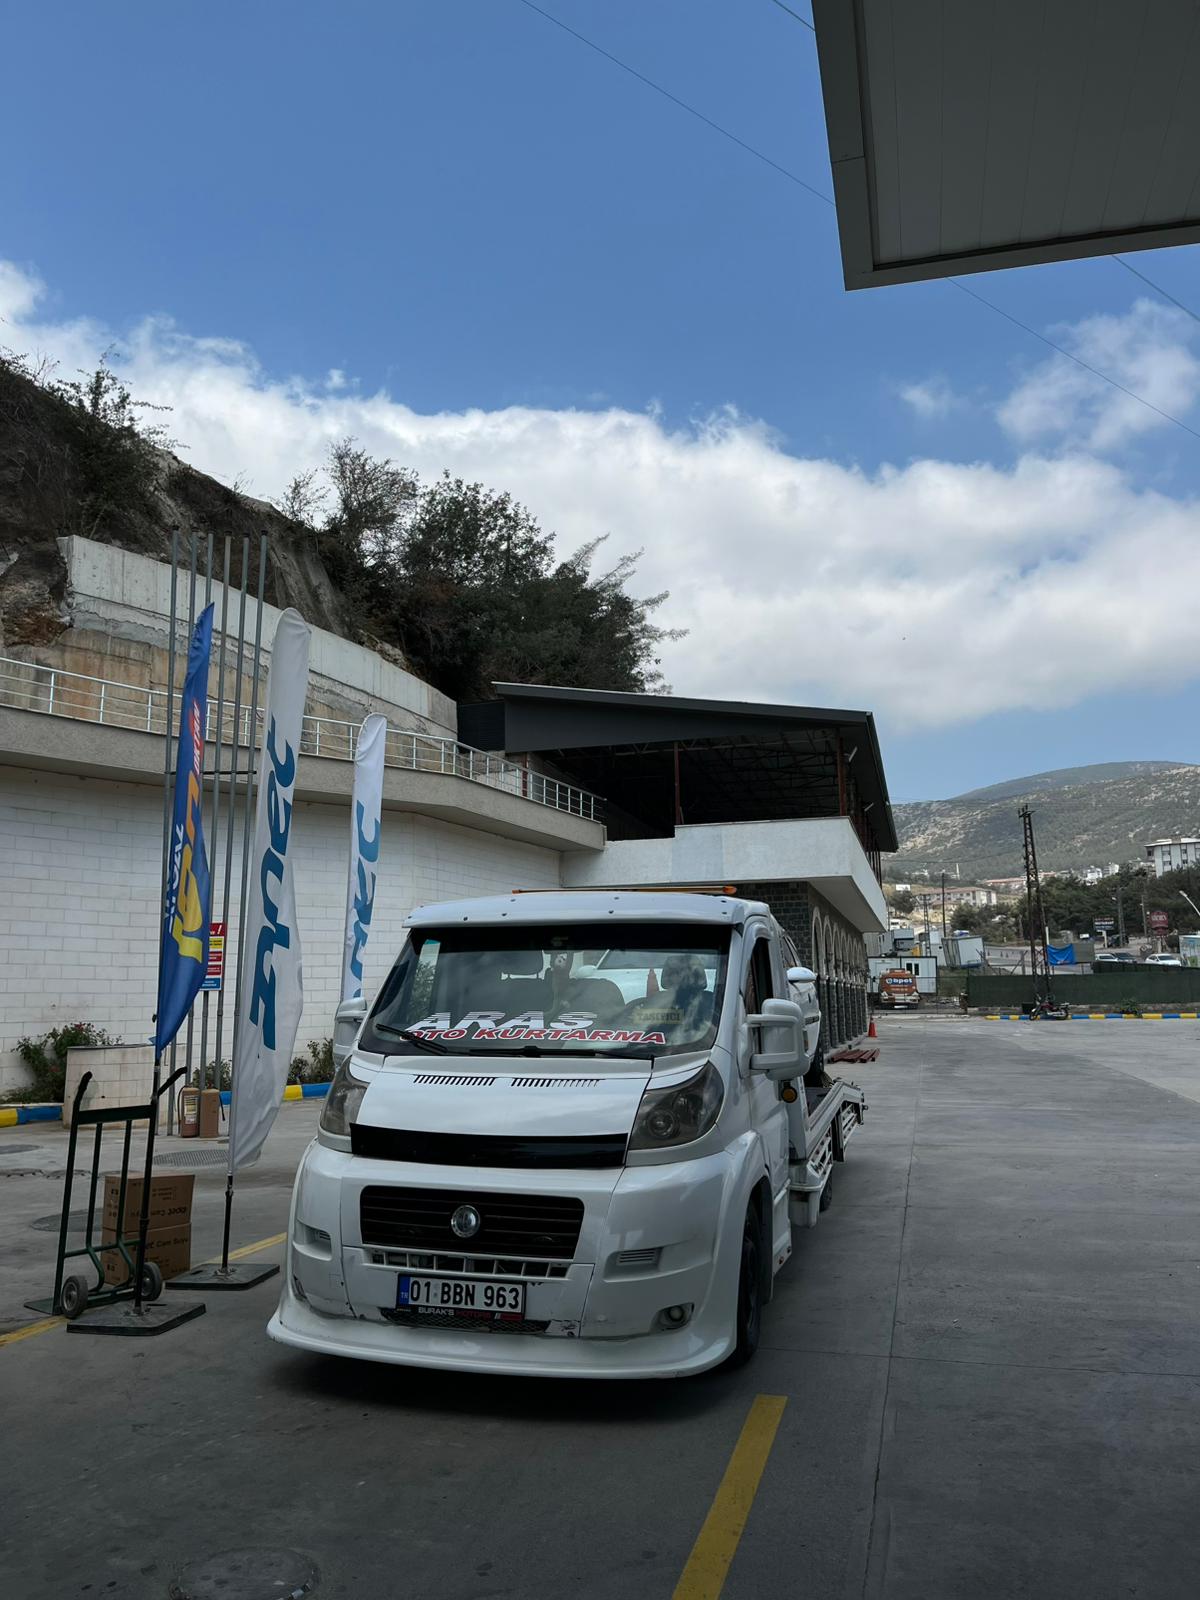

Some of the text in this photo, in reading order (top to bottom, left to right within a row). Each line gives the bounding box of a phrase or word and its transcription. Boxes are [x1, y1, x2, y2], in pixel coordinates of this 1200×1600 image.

[404, 1010, 598, 1031] ARAS
[471, 1027, 668, 1045] KURTARMA
[410, 1280, 520, 1310] 01 BBN 963
[418, 1306, 455, 1317] BURAK'S
